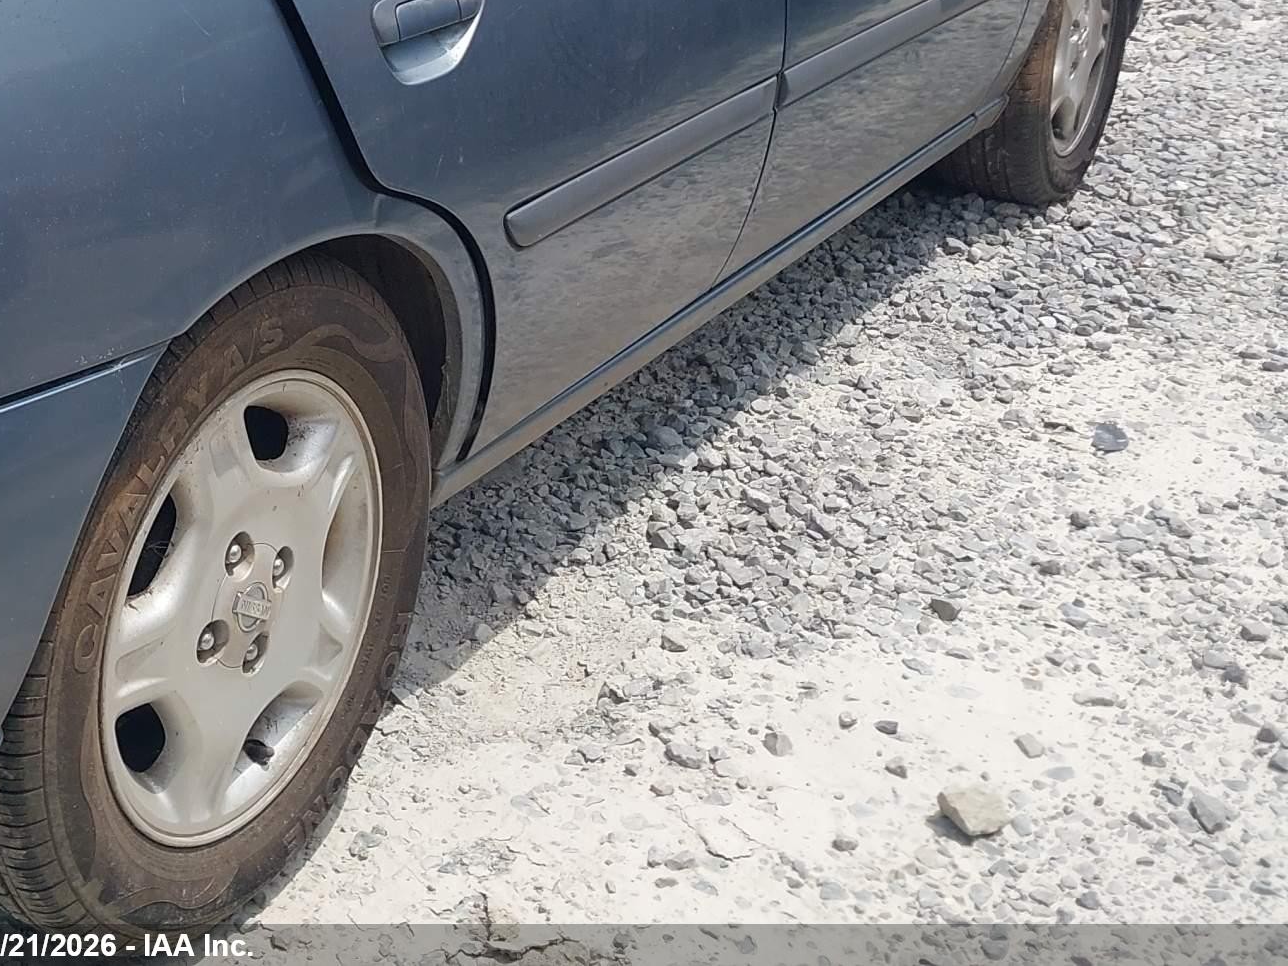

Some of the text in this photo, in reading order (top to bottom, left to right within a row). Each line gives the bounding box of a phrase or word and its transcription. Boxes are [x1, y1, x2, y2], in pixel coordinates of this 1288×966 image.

[73, 314, 285, 675] CAVALRY A/S
[240, 598, 271, 618] NISSAN
